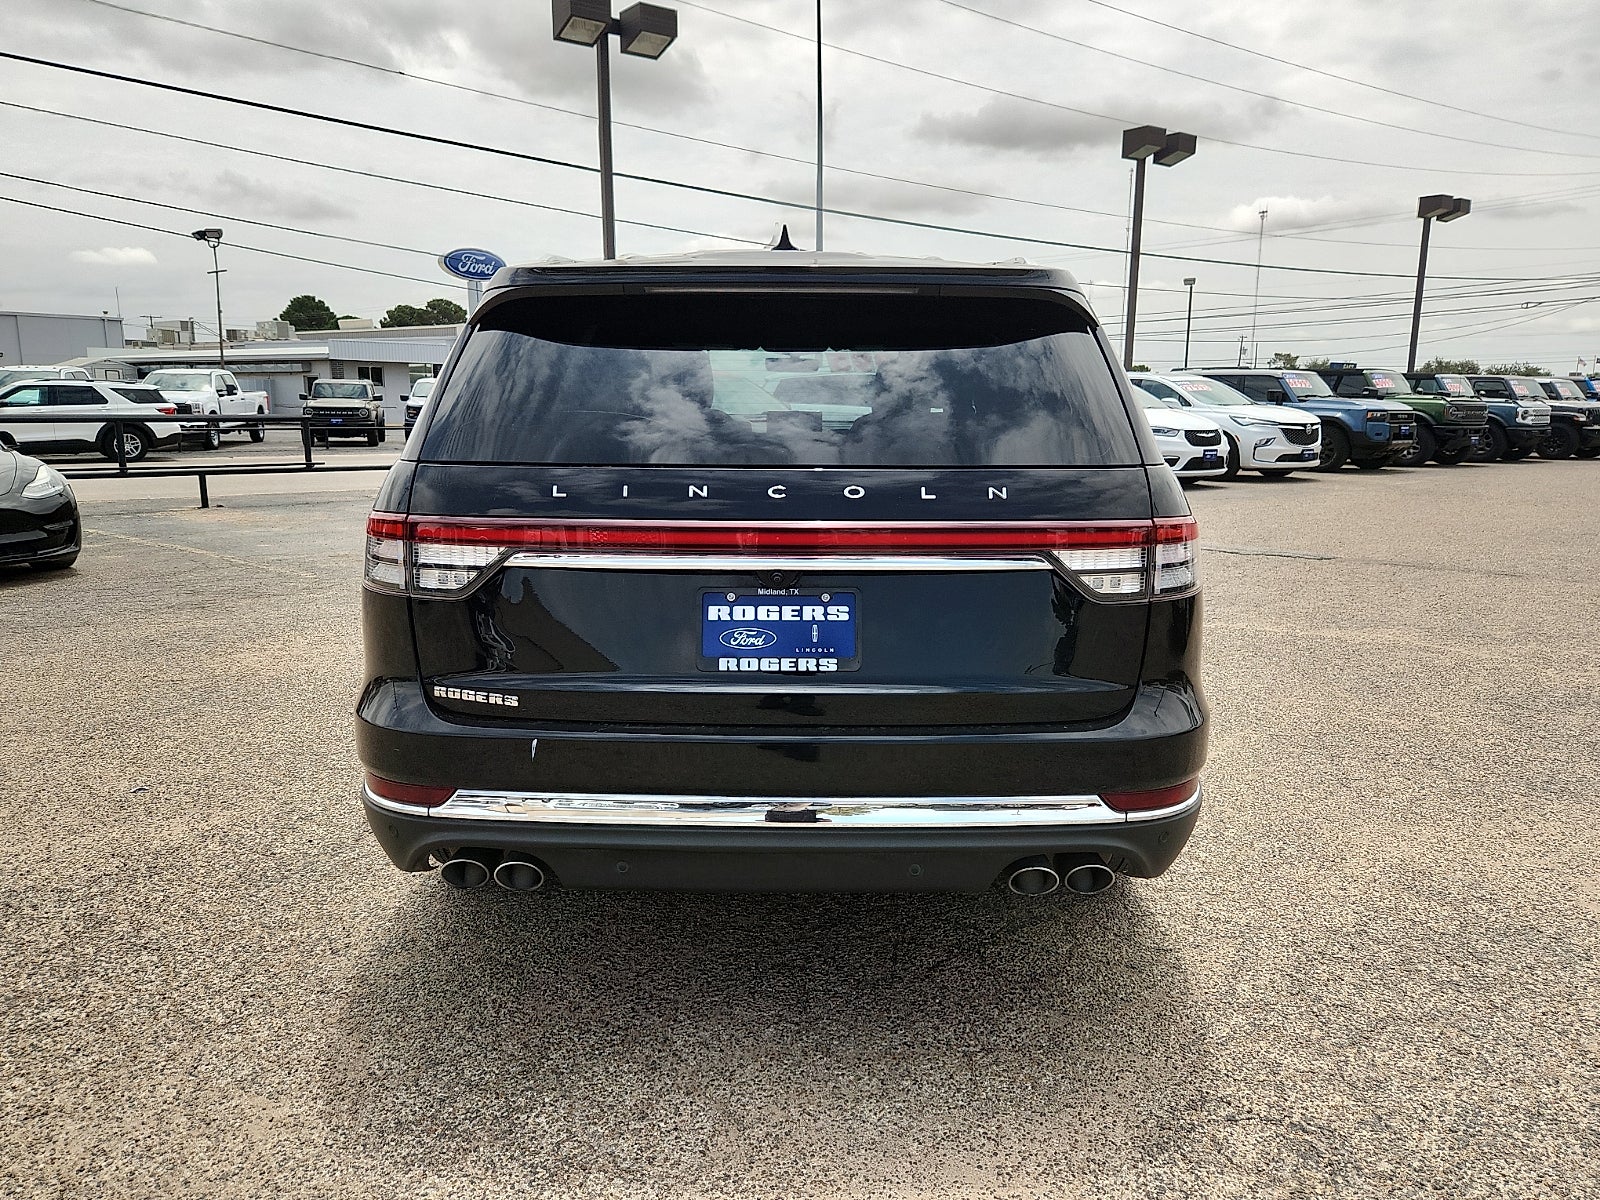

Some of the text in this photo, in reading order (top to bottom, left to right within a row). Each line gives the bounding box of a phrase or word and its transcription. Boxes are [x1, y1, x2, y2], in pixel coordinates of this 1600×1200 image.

[458, 253, 496, 275] Ford
[552, 485, 1008, 501] LINCOLN
[757, 588, 800, 597] Midland, TX
[707, 605, 850, 621] ROGERS
[730, 630, 766, 647] Ford
[718, 657, 839, 672] ROGERS
[433, 685, 519, 707] ROGERS
